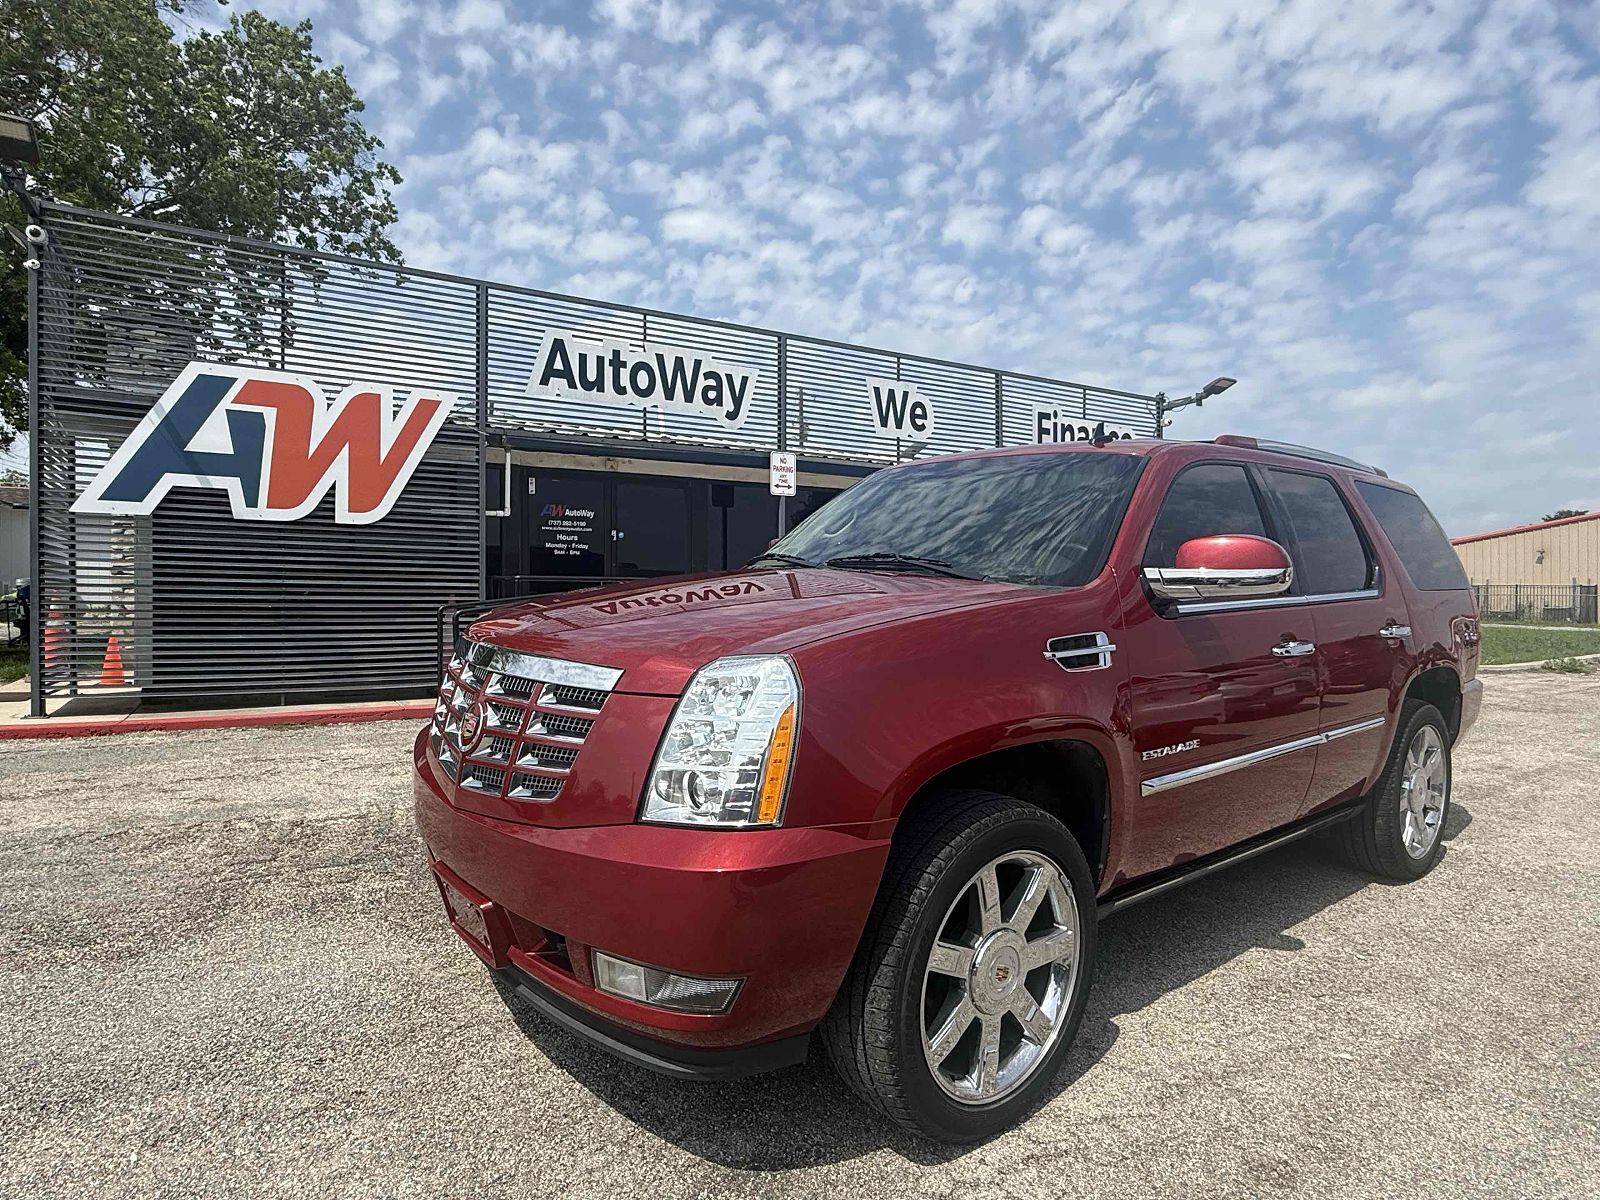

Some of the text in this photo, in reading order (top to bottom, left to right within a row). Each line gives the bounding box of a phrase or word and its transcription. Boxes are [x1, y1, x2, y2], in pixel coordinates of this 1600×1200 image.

[538, 337, 1133, 443] AutoWay We Fina
[97, 373, 443, 513] AW
[773, 465, 794, 473] PARKING
[564, 508, 595, 519] AutoWay
[556, 533, 578, 541] Hours
